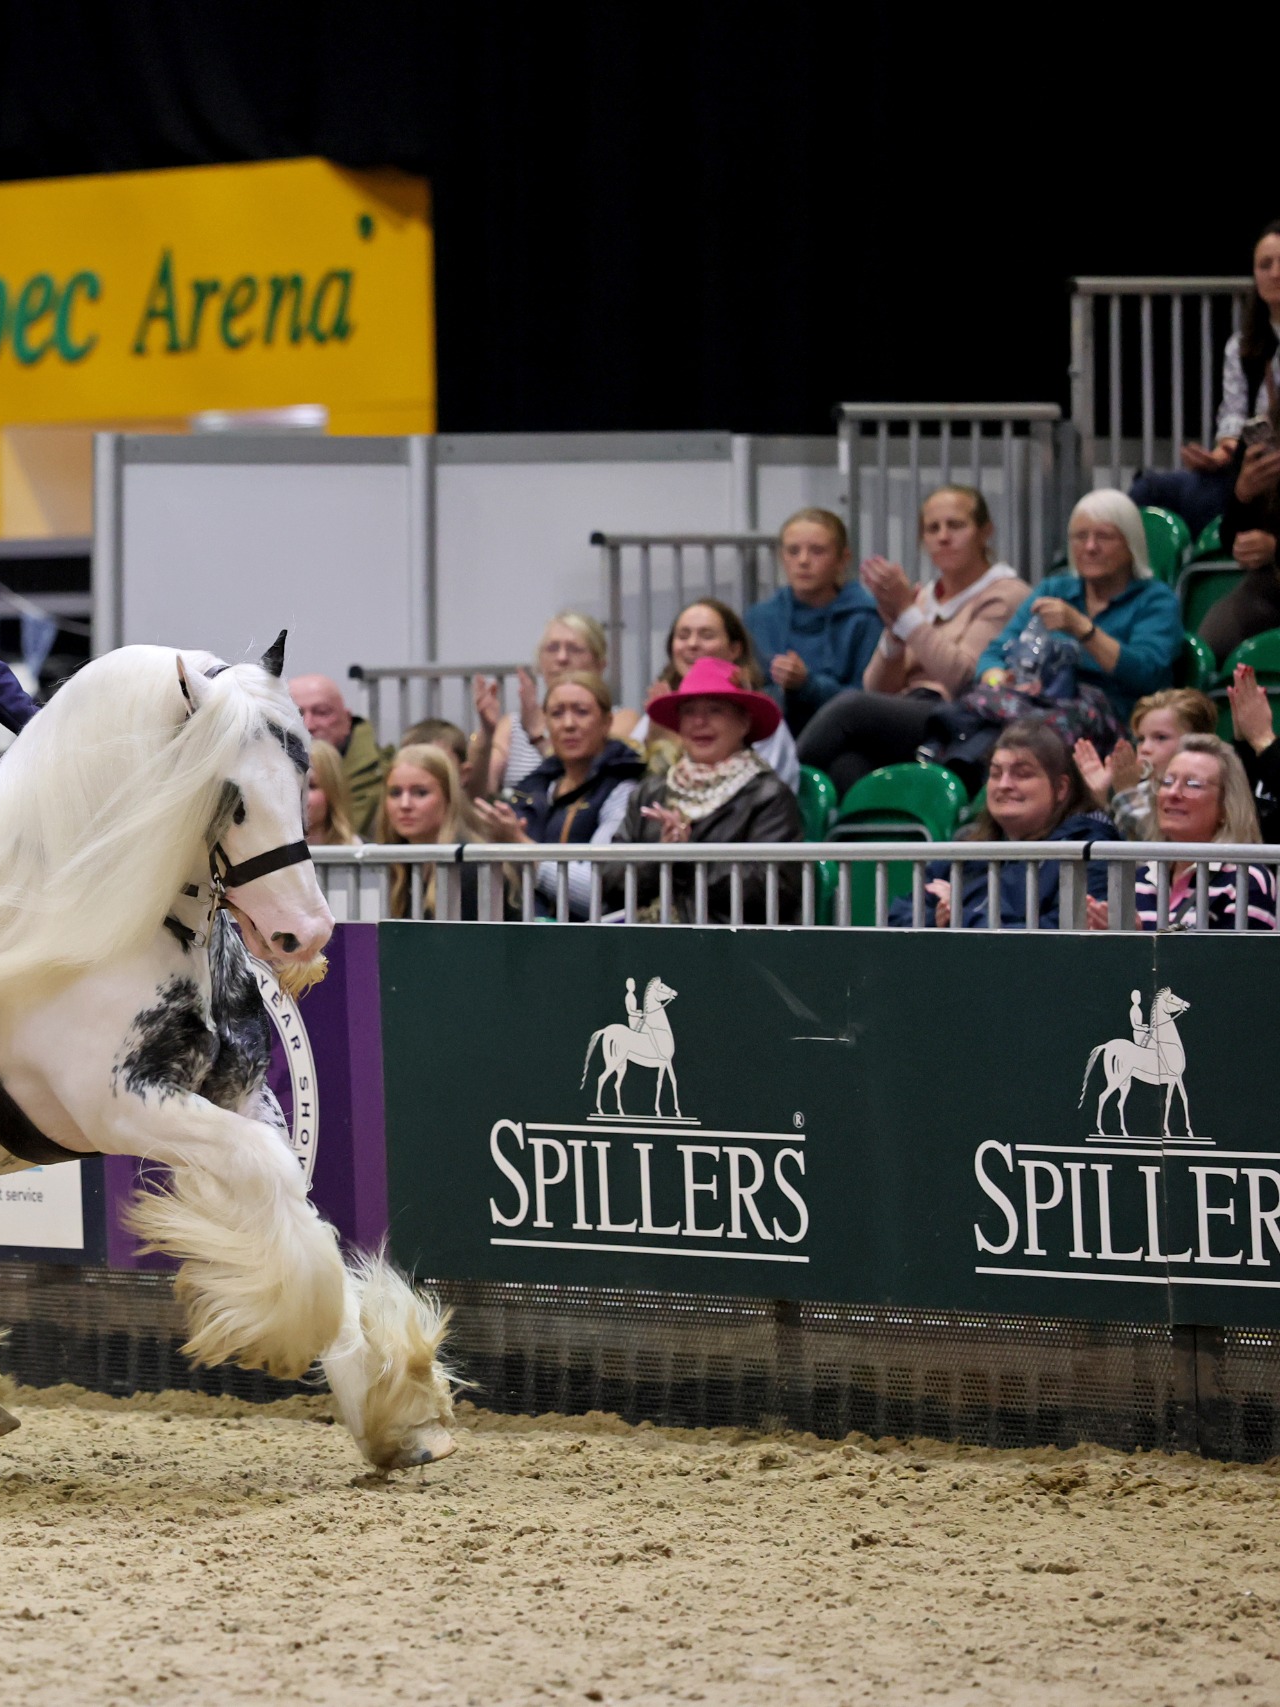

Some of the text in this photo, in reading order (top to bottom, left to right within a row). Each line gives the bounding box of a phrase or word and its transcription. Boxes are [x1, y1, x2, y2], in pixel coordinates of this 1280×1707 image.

[130, 247, 358, 357] Arena
[258, 973, 302, 1051] YEAR
[5, 1186, 44, 1203] service
[489, 1118, 810, 1244] SPILLERS
